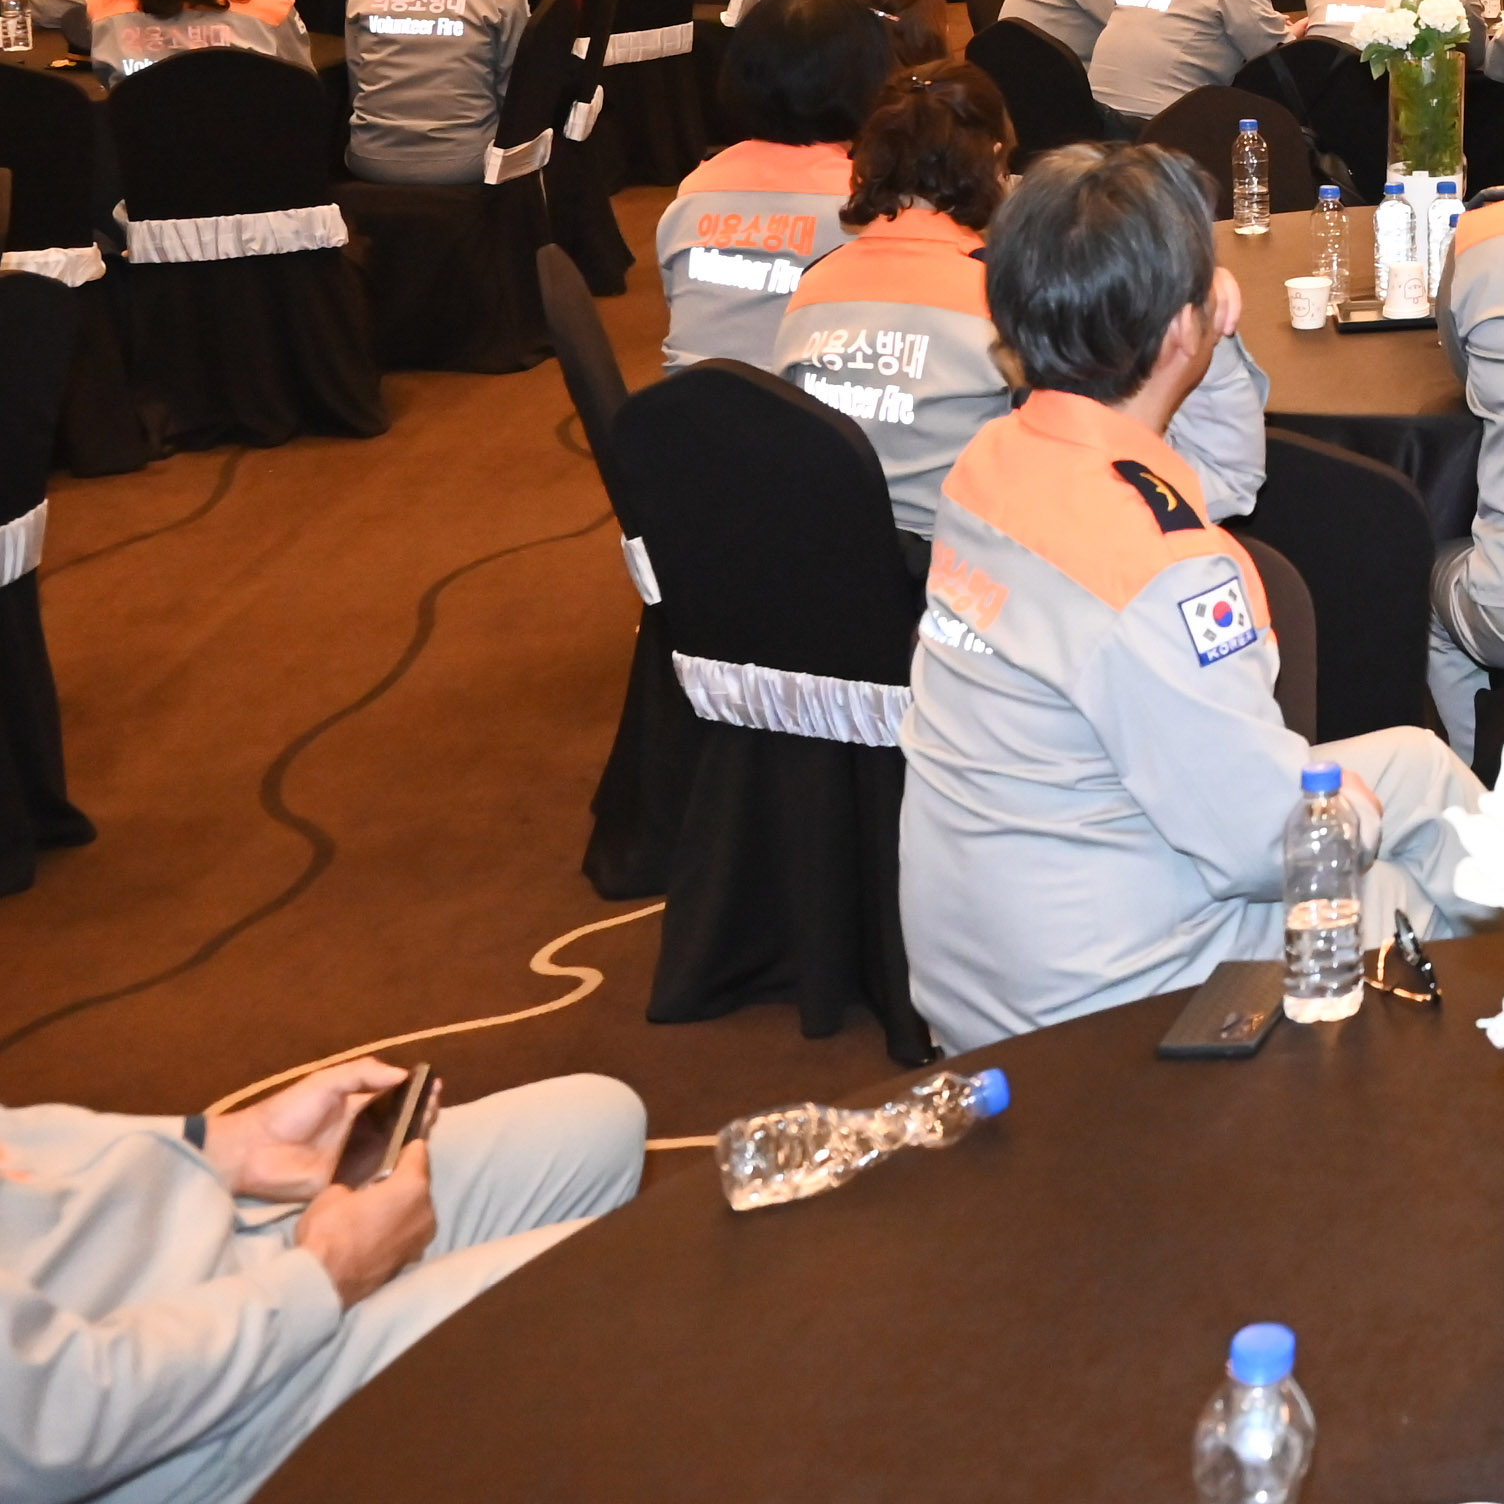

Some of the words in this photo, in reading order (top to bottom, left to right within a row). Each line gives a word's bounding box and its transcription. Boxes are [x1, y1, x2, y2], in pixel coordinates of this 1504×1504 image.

[369, 15, 434, 34] Volunteer
[437, 16, 465, 36] Fire
[697, 212, 817, 256] 의용소방대
[802, 328, 930, 381] 의용소방대
[1206, 629, 1256, 662] KOREA
